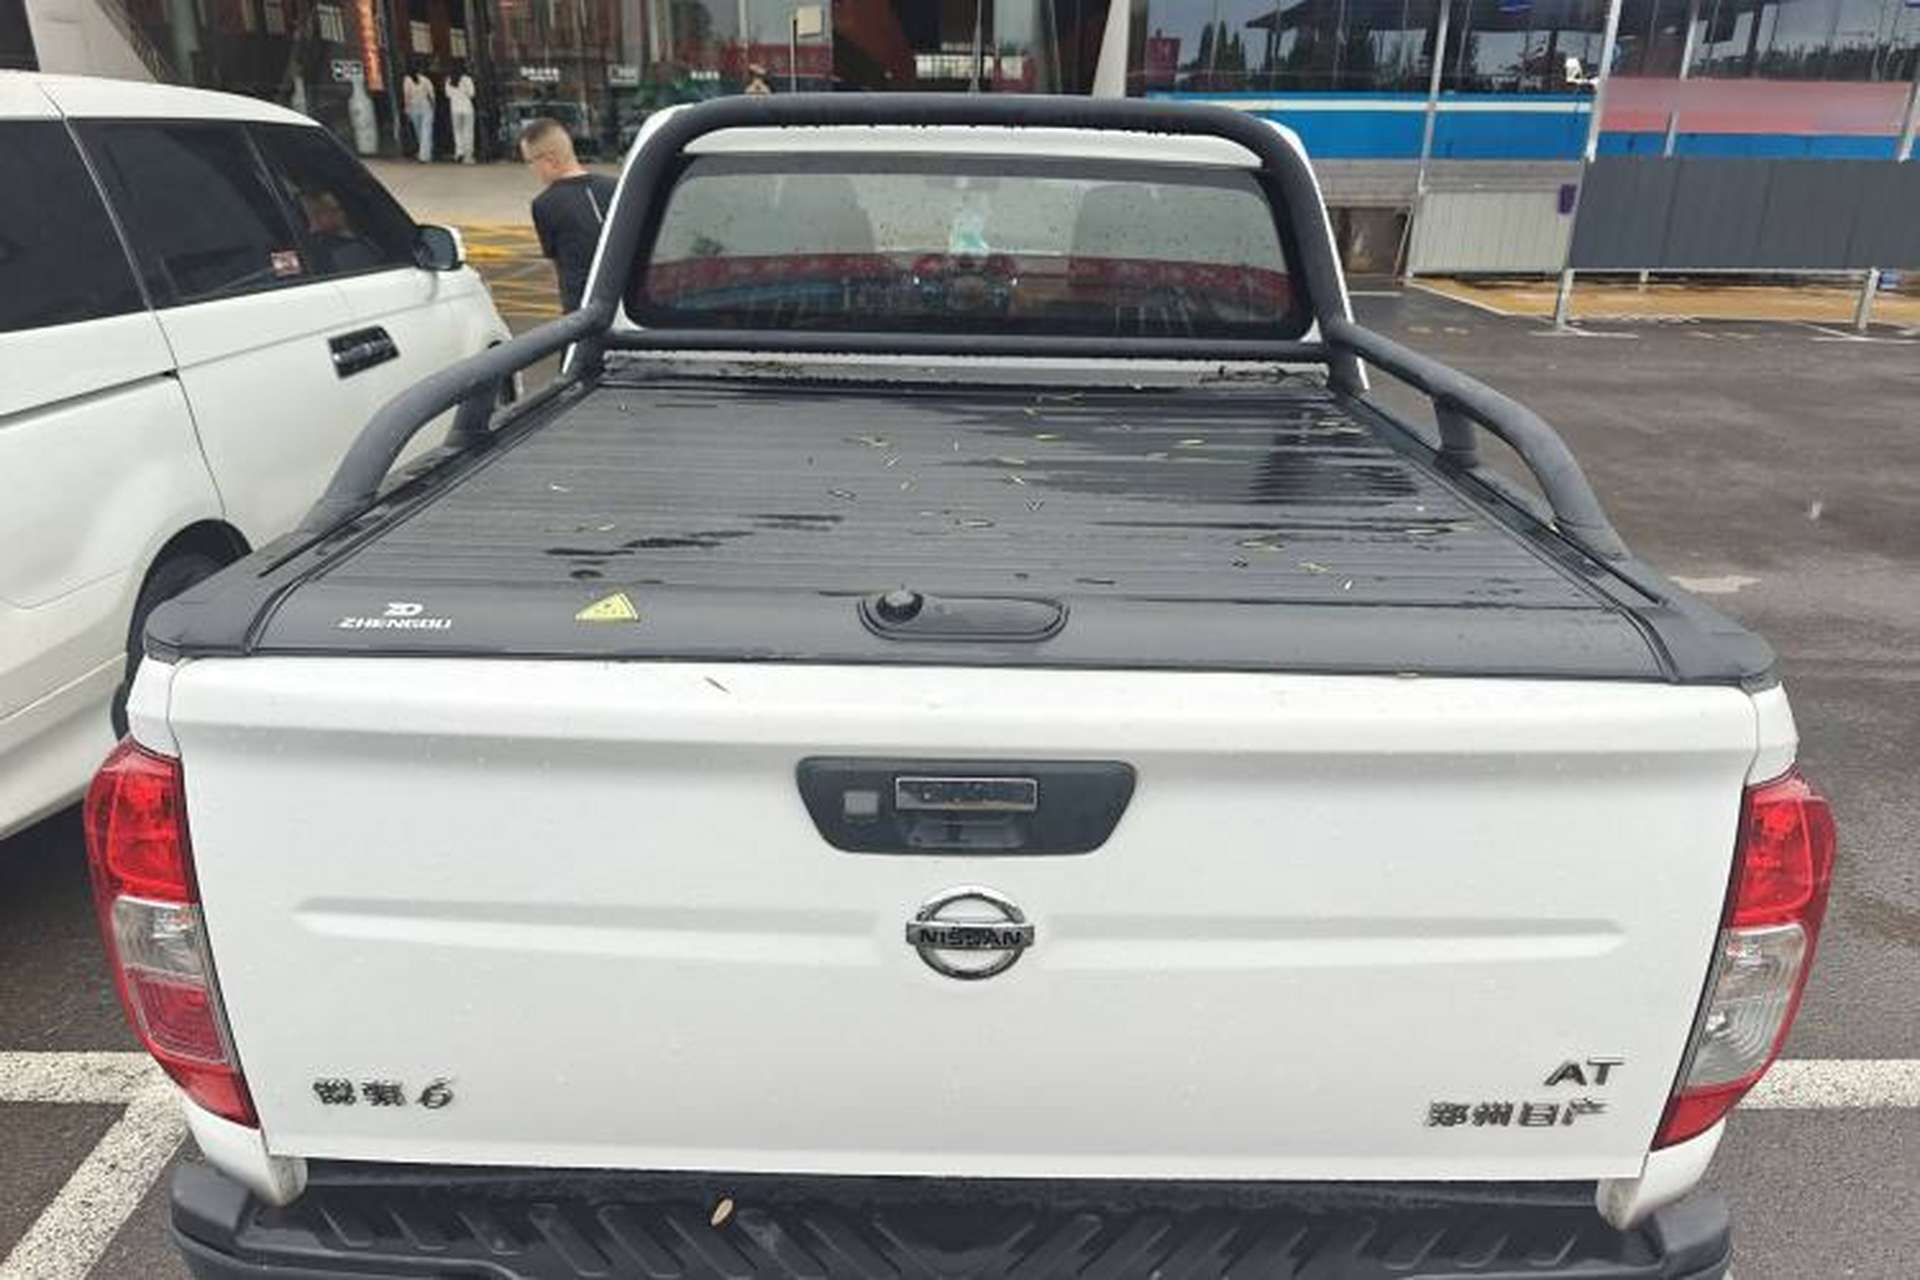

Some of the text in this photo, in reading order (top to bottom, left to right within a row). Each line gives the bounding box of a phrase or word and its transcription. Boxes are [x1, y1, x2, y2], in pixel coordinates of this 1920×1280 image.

[920, 927, 1021, 945] NISSAN
[1544, 1056, 1624, 1086] AT
[1427, 1097, 1608, 1127] 郑州日产
